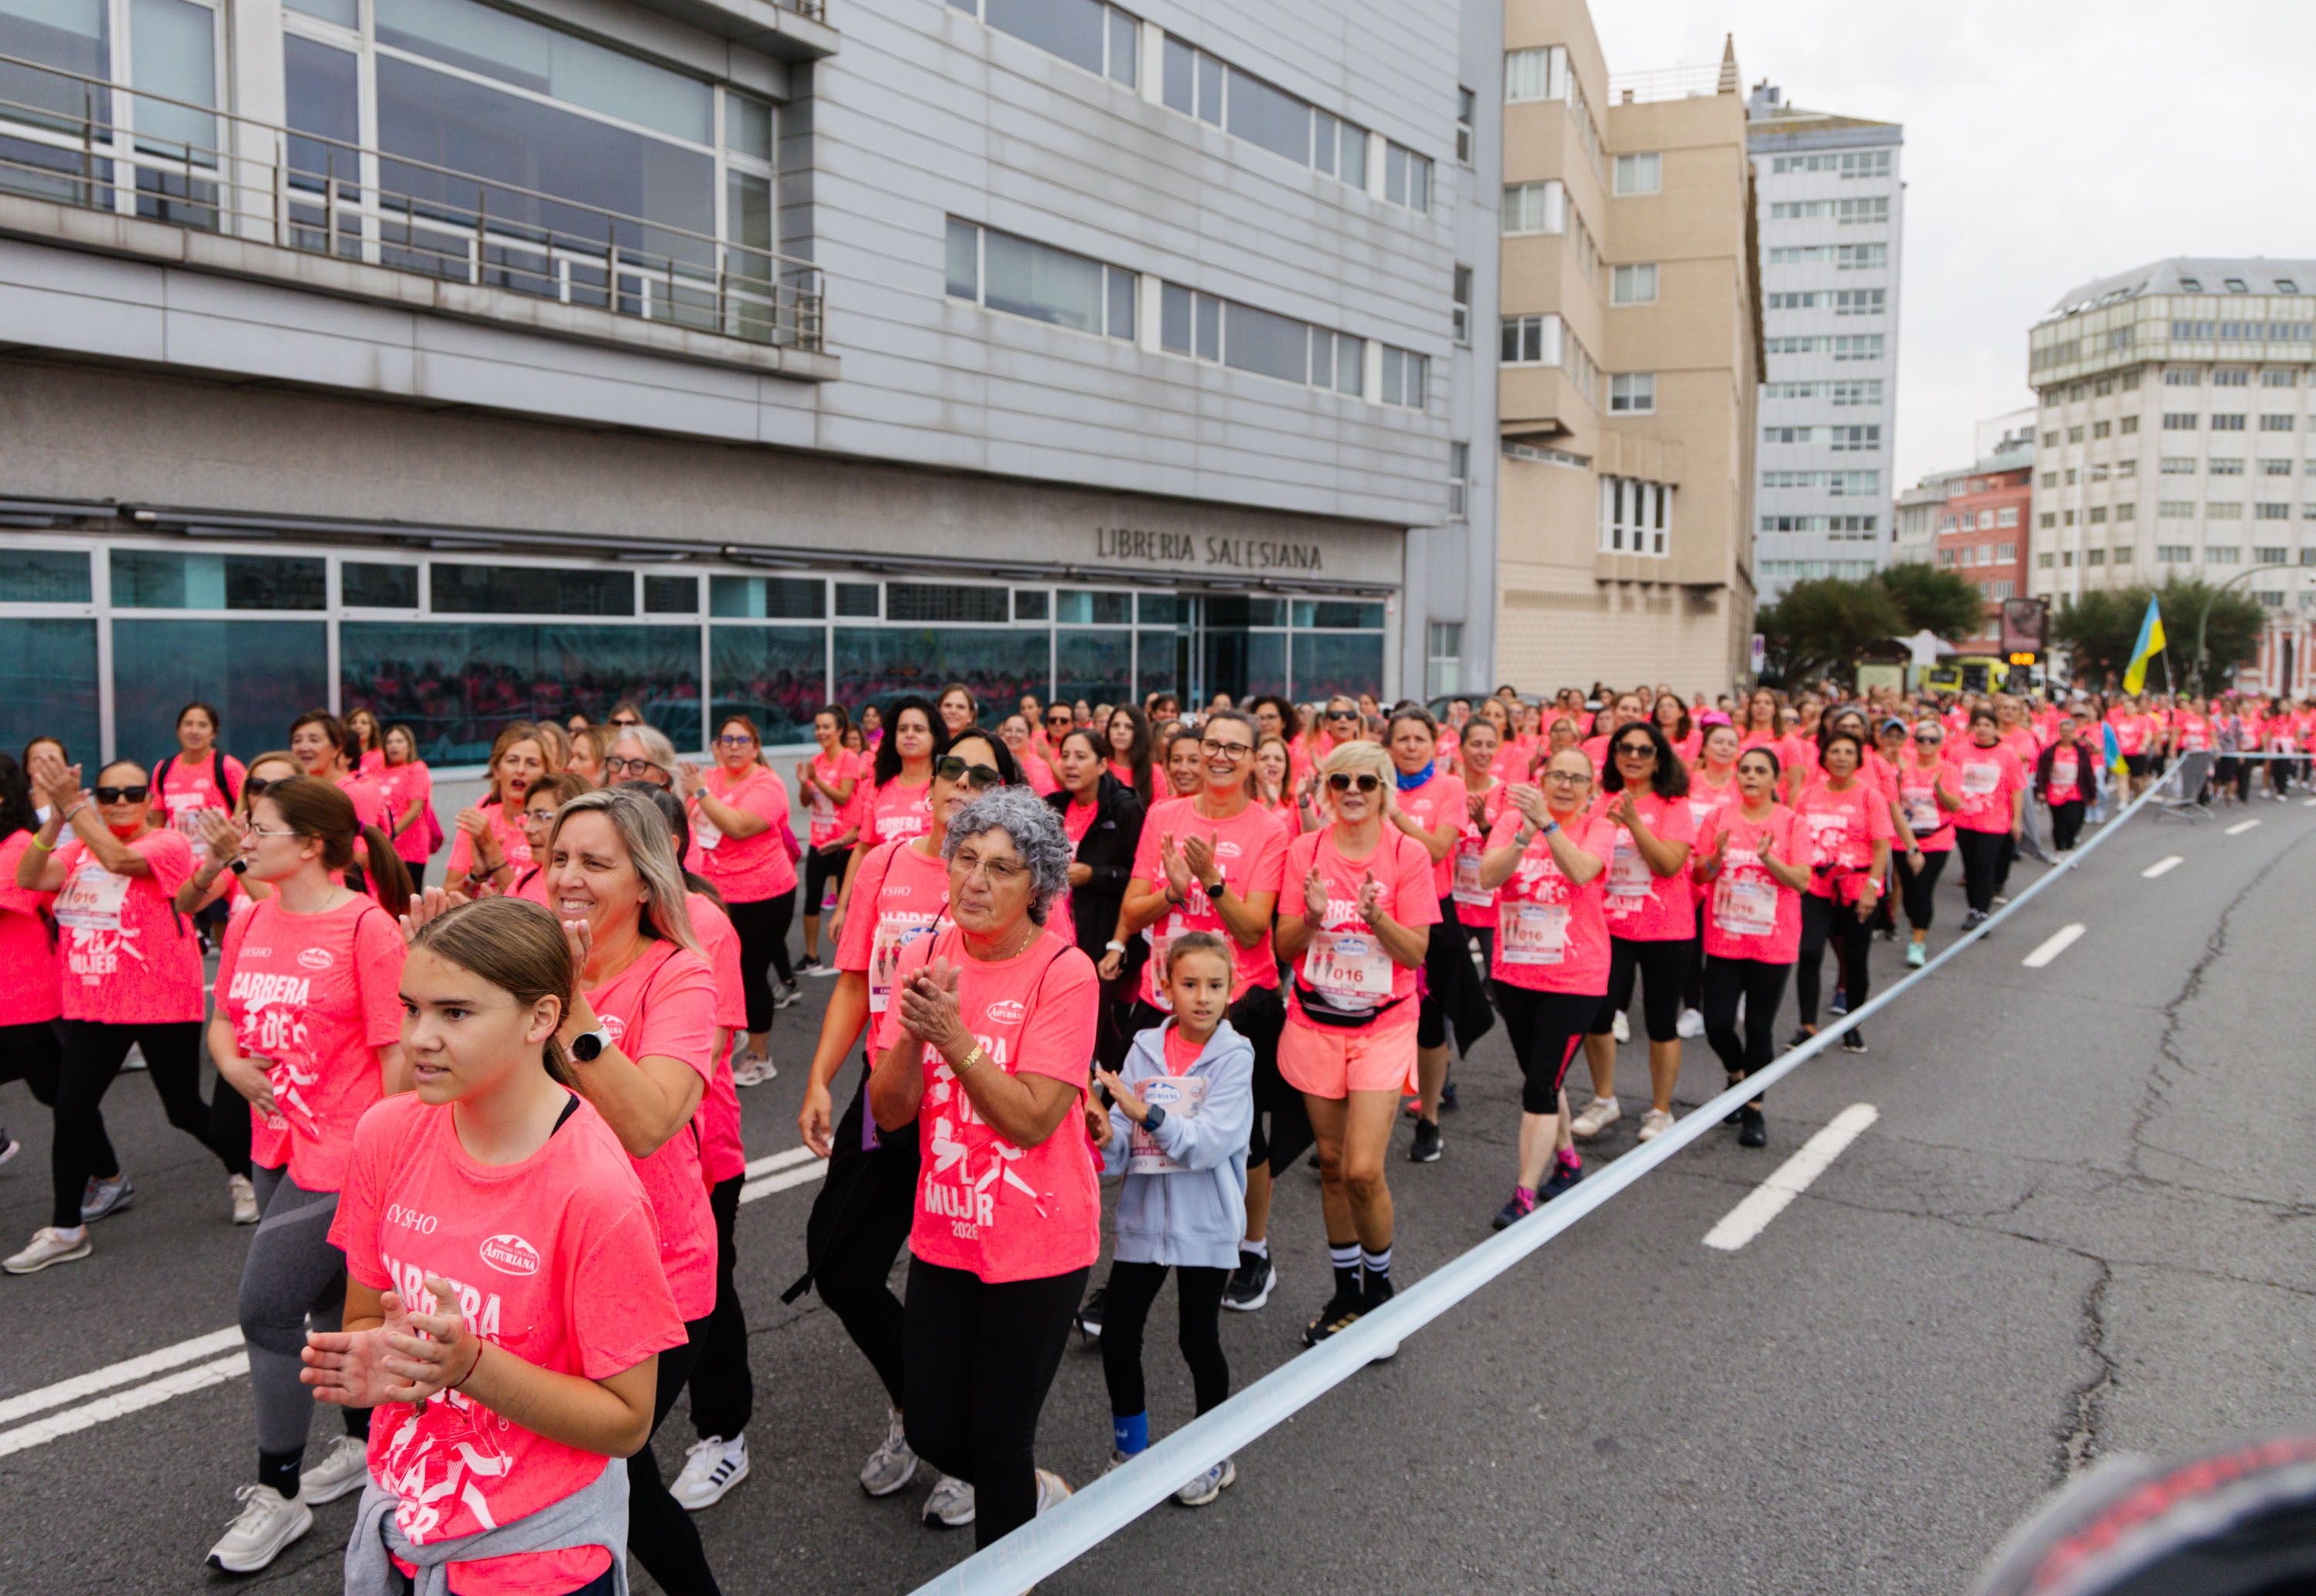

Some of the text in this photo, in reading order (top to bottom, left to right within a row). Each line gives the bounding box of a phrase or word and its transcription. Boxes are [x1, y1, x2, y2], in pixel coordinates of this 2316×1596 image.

[1096, 527, 1323, 570] LIBRERIA SALESIANA
[882, 887, 911, 897] YSHO
[229, 972, 310, 1005] CARRERA
[1333, 969, 1364, 983] 016
[926, 1181, 994, 1227] MUJR
[483, 1242, 536, 1272] ASTURIANA
